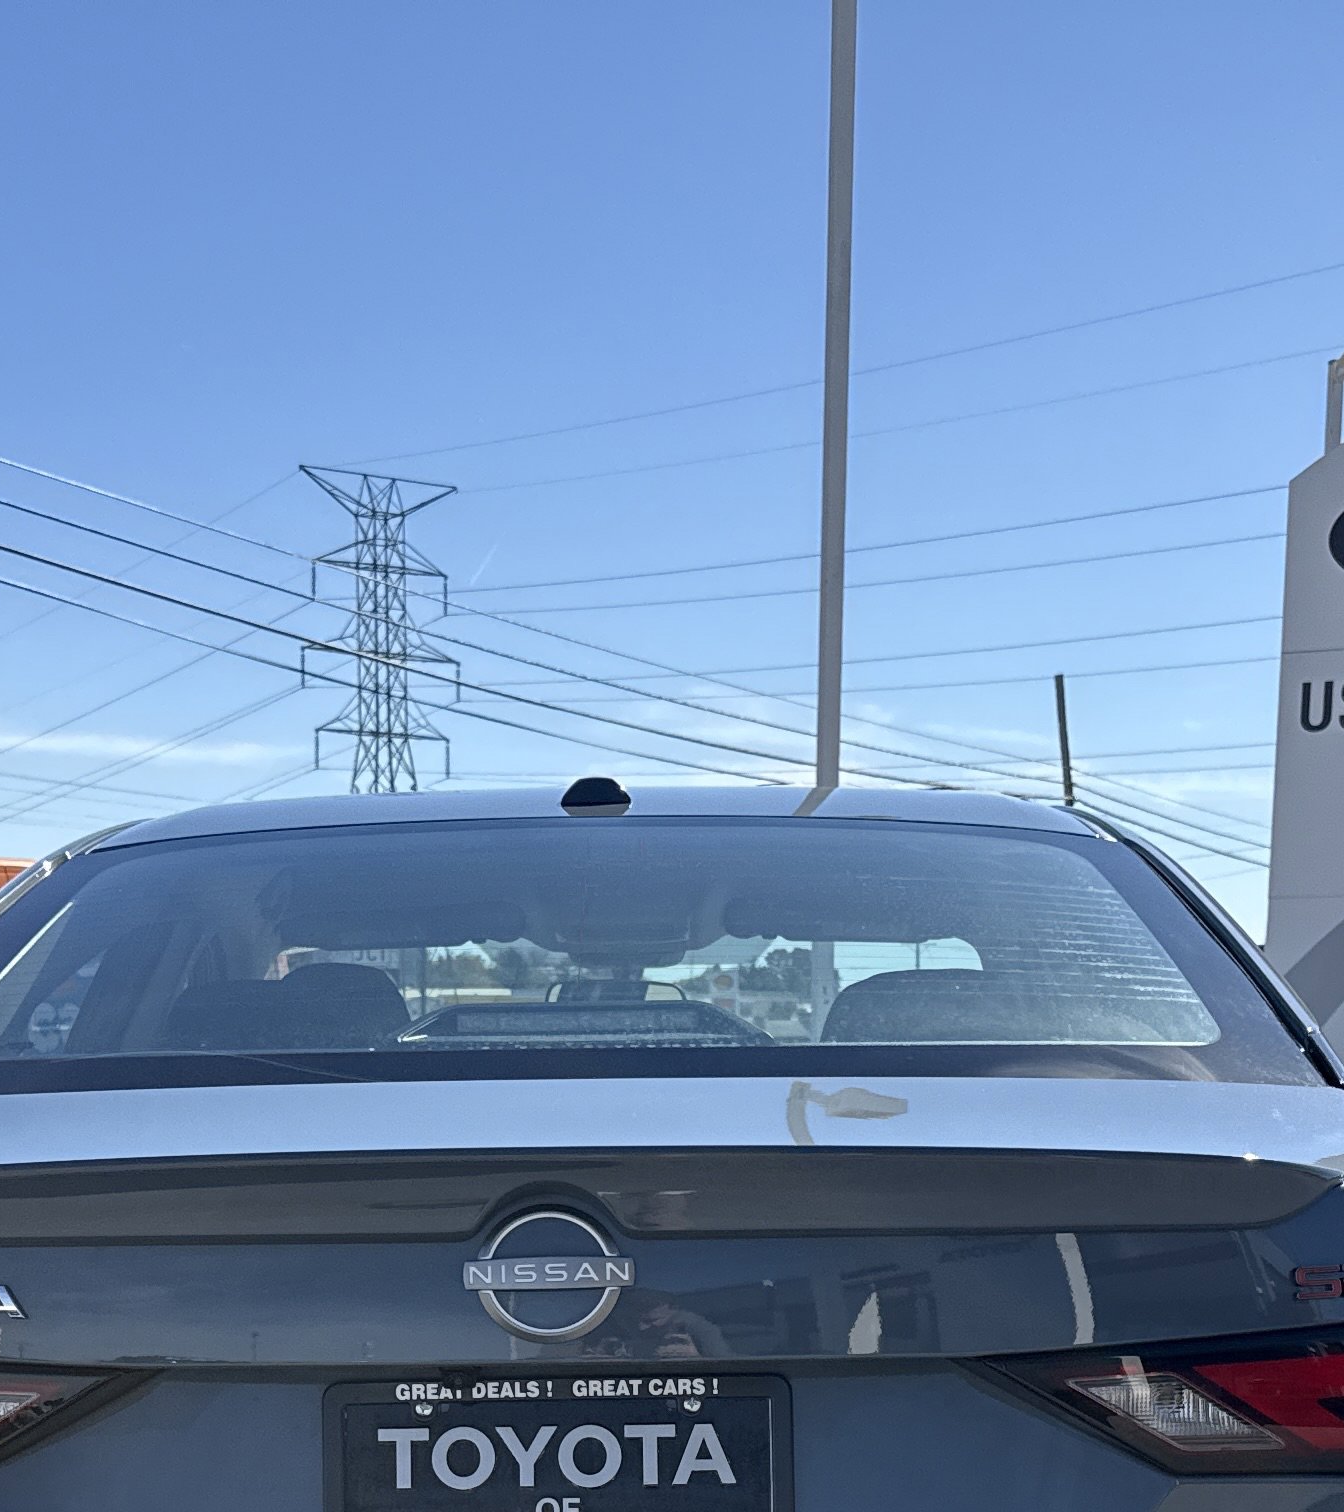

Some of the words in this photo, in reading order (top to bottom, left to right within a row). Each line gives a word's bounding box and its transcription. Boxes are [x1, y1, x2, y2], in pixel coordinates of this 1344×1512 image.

[468, 1262, 630, 1285] NISSAN
[471, 1381, 540, 1399] DEALS
[572, 1379, 643, 1397] GREAT
[648, 1378, 706, 1396] CARS
[377, 1423, 737, 1491] TOYOTA
